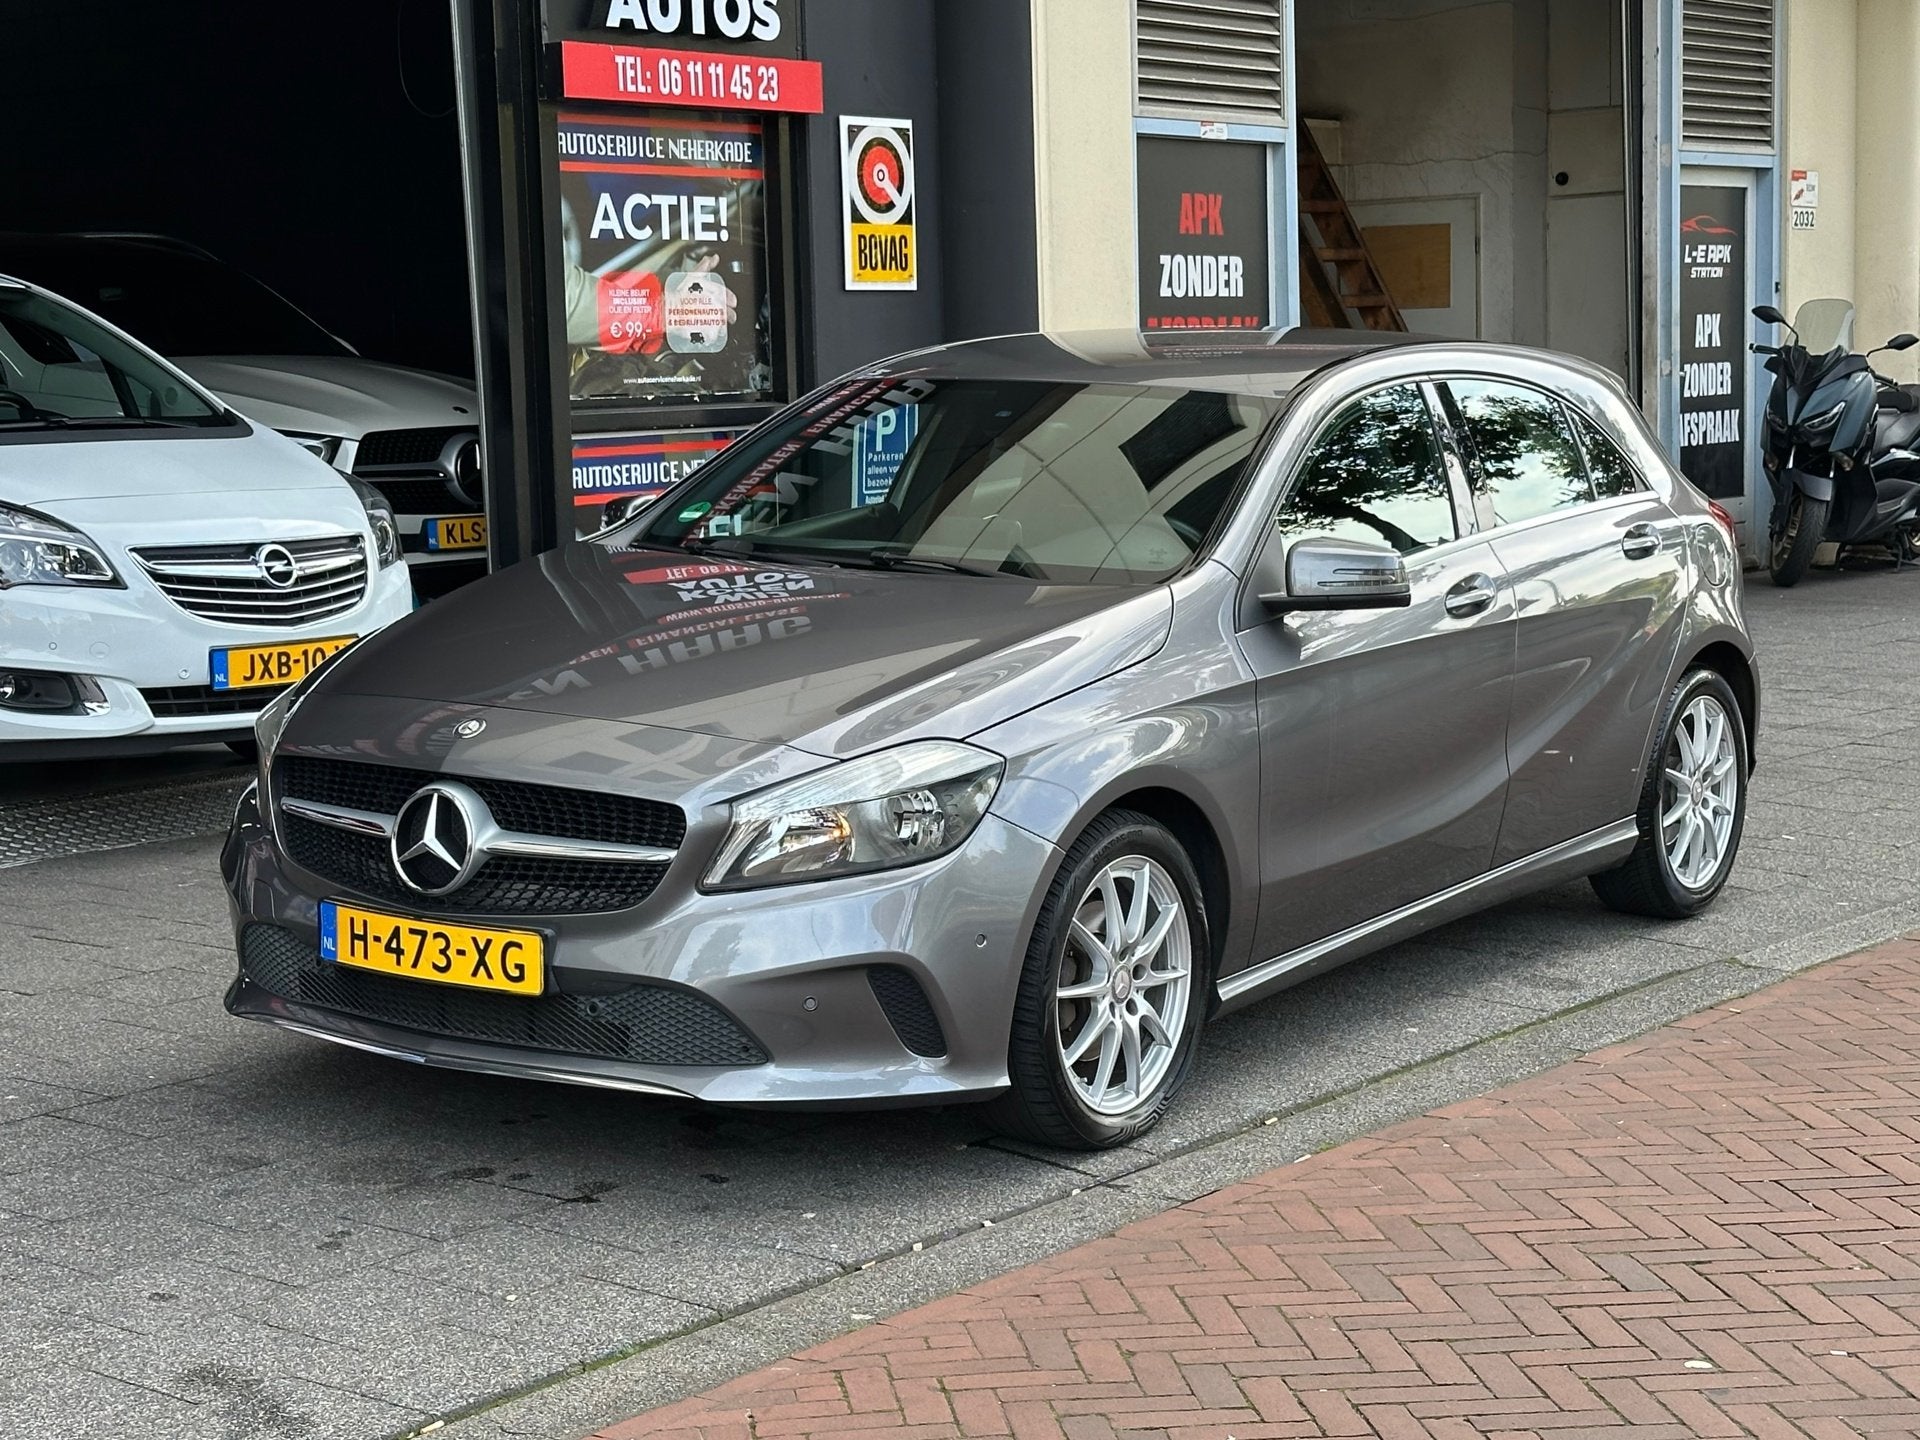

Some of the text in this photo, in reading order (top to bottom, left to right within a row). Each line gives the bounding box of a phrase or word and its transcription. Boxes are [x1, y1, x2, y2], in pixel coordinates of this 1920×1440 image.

[606, 0, 781, 41] AUTOS
[615, 55, 779, 102] TEL: 06 11 11 45 23
[558, 132, 753, 163] AUTOSERVICE NEHERKADE
[589, 192, 730, 242] ACTIE!
[1178, 192, 1225, 236] APK
[1793, 210, 1816, 228] 2032
[857, 233, 909, 272] BOVAG
[1159, 254, 1245, 298] ZONDER
[1690, 267, 1724, 278] STATION
[1695, 313, 1721, 348] APK
[1683, 361, 1732, 397] ZONDER
[573, 461, 679, 489] AUTOSERVICE
[867, 465, 888, 474] alleen
[868, 453, 904, 462] Parkeren
[429, 537, 438, 545] NL
[215, 645, 347, 683] NL JXB-10
[323, 916, 526, 983] NL H-473-XG
